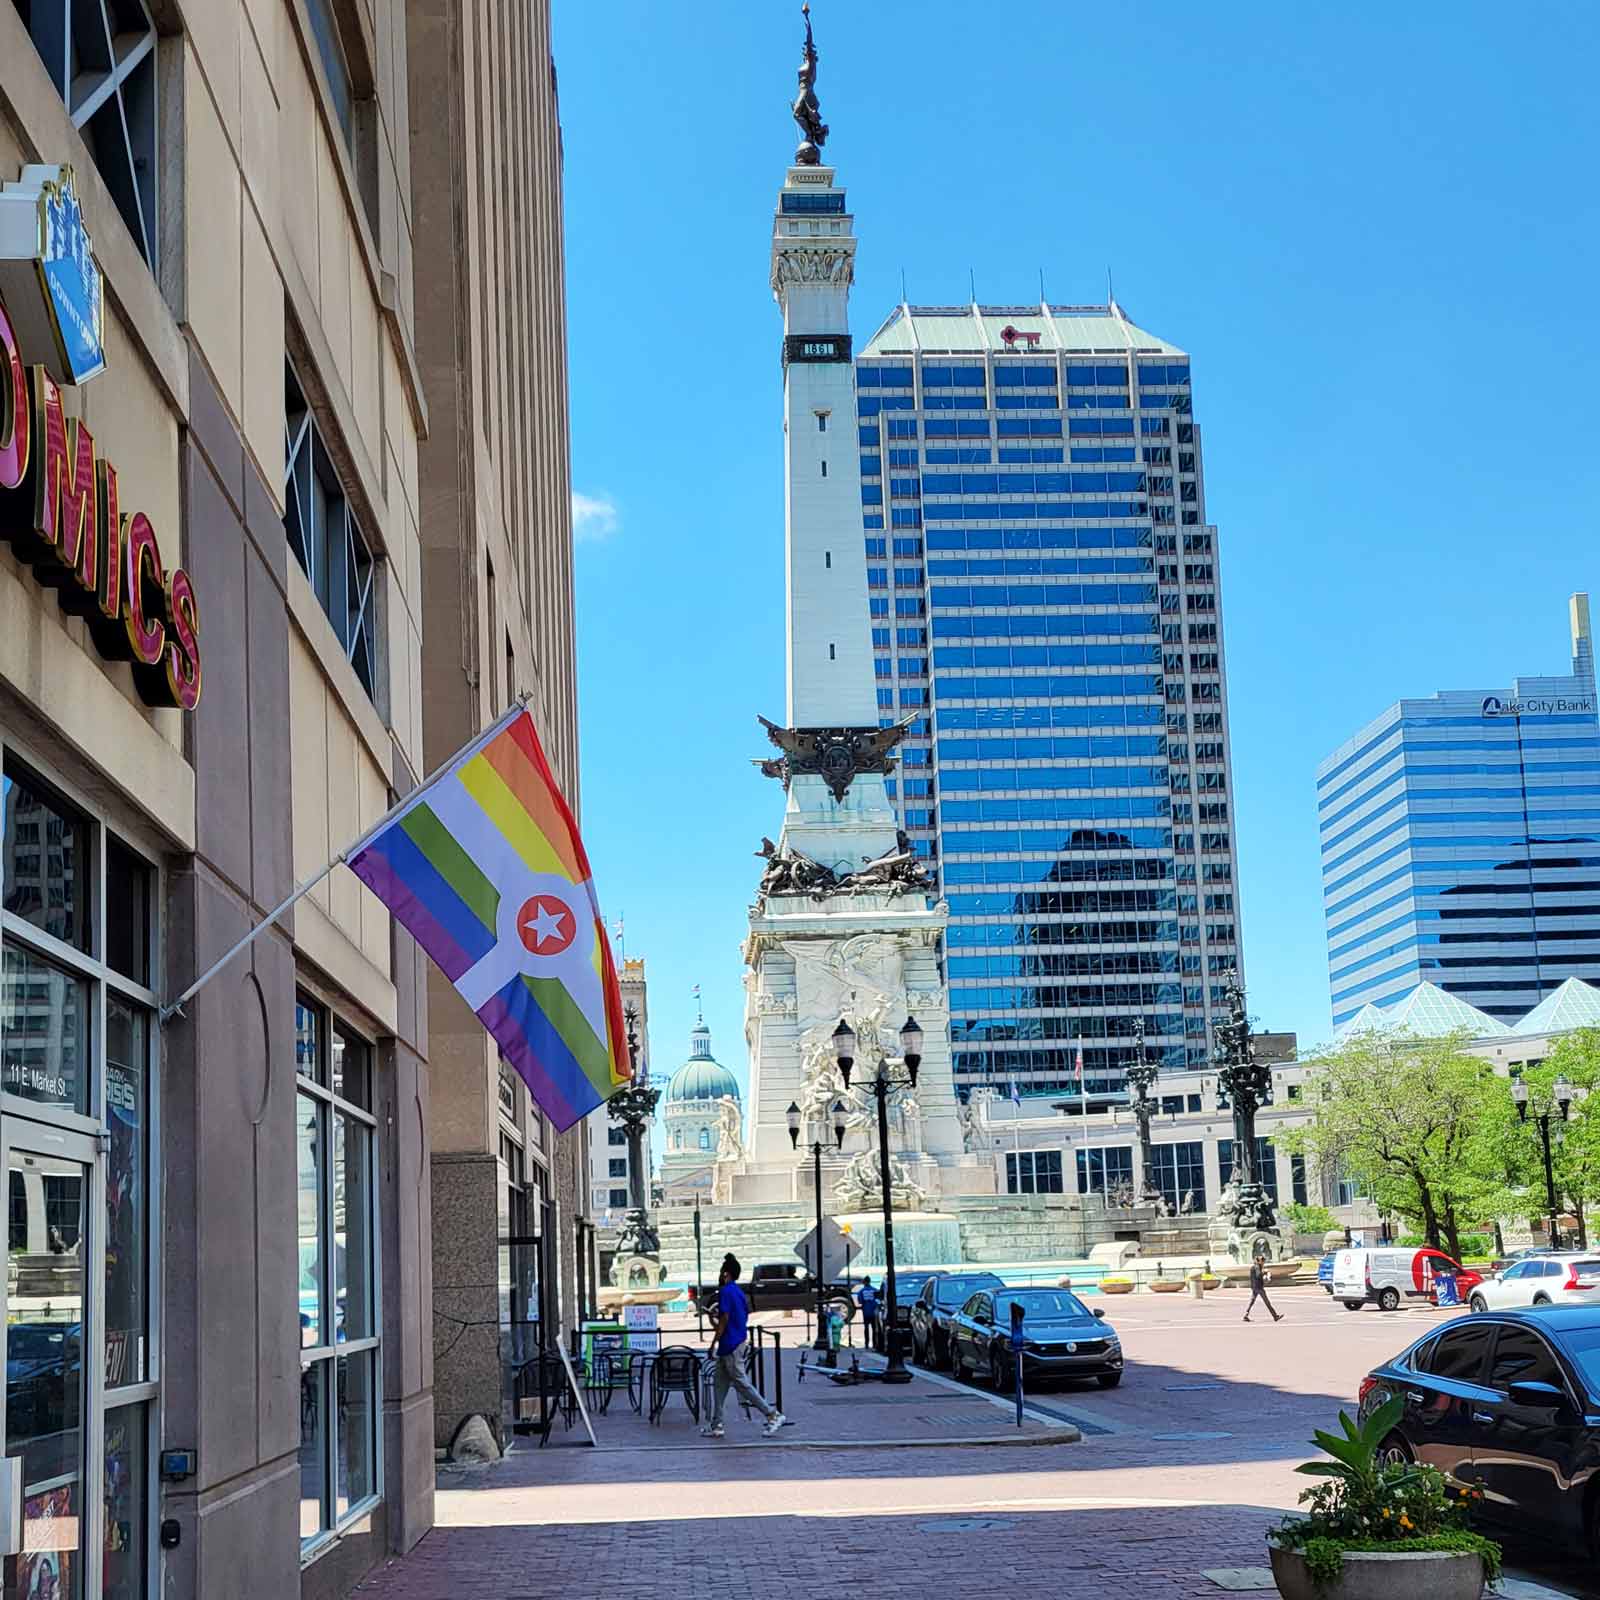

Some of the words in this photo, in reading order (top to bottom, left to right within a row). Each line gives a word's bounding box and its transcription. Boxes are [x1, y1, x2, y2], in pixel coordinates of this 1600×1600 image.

[50, 271, 98, 360] DOWNTOWN
[1527, 700, 1554, 714] City
[1557, 699, 1591, 712] Bank
[10, 1063, 19, 1083] 11
[31, 1069, 57, 1097] Market
